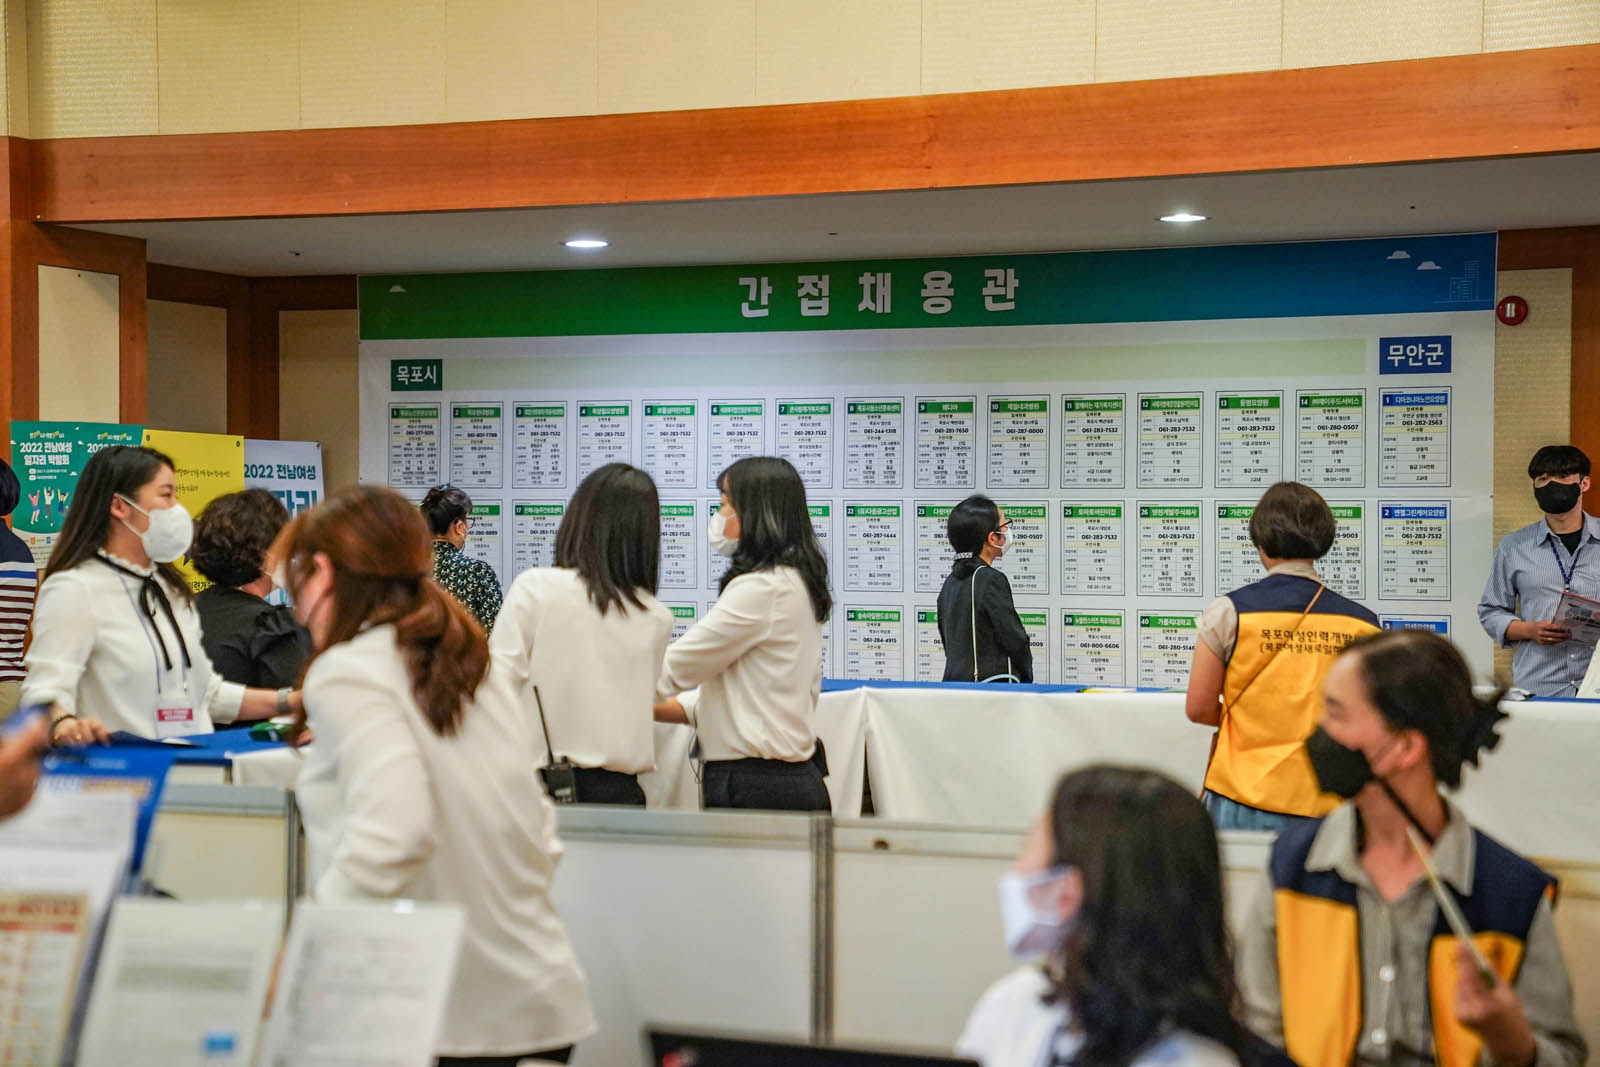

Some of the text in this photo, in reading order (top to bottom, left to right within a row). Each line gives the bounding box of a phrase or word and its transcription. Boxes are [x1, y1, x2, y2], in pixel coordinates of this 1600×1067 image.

[739, 268, 1019, 318] 간접채용관
[1387, 344, 1444, 366] 무안군
[396, 365, 436, 384] 목포시
[20, 442, 72, 453] 2022 전남여성
[24, 455, 70, 465] 일자리 박람회
[244, 464, 273, 478] 2022
[276, 464, 316, 480] 전남여성
